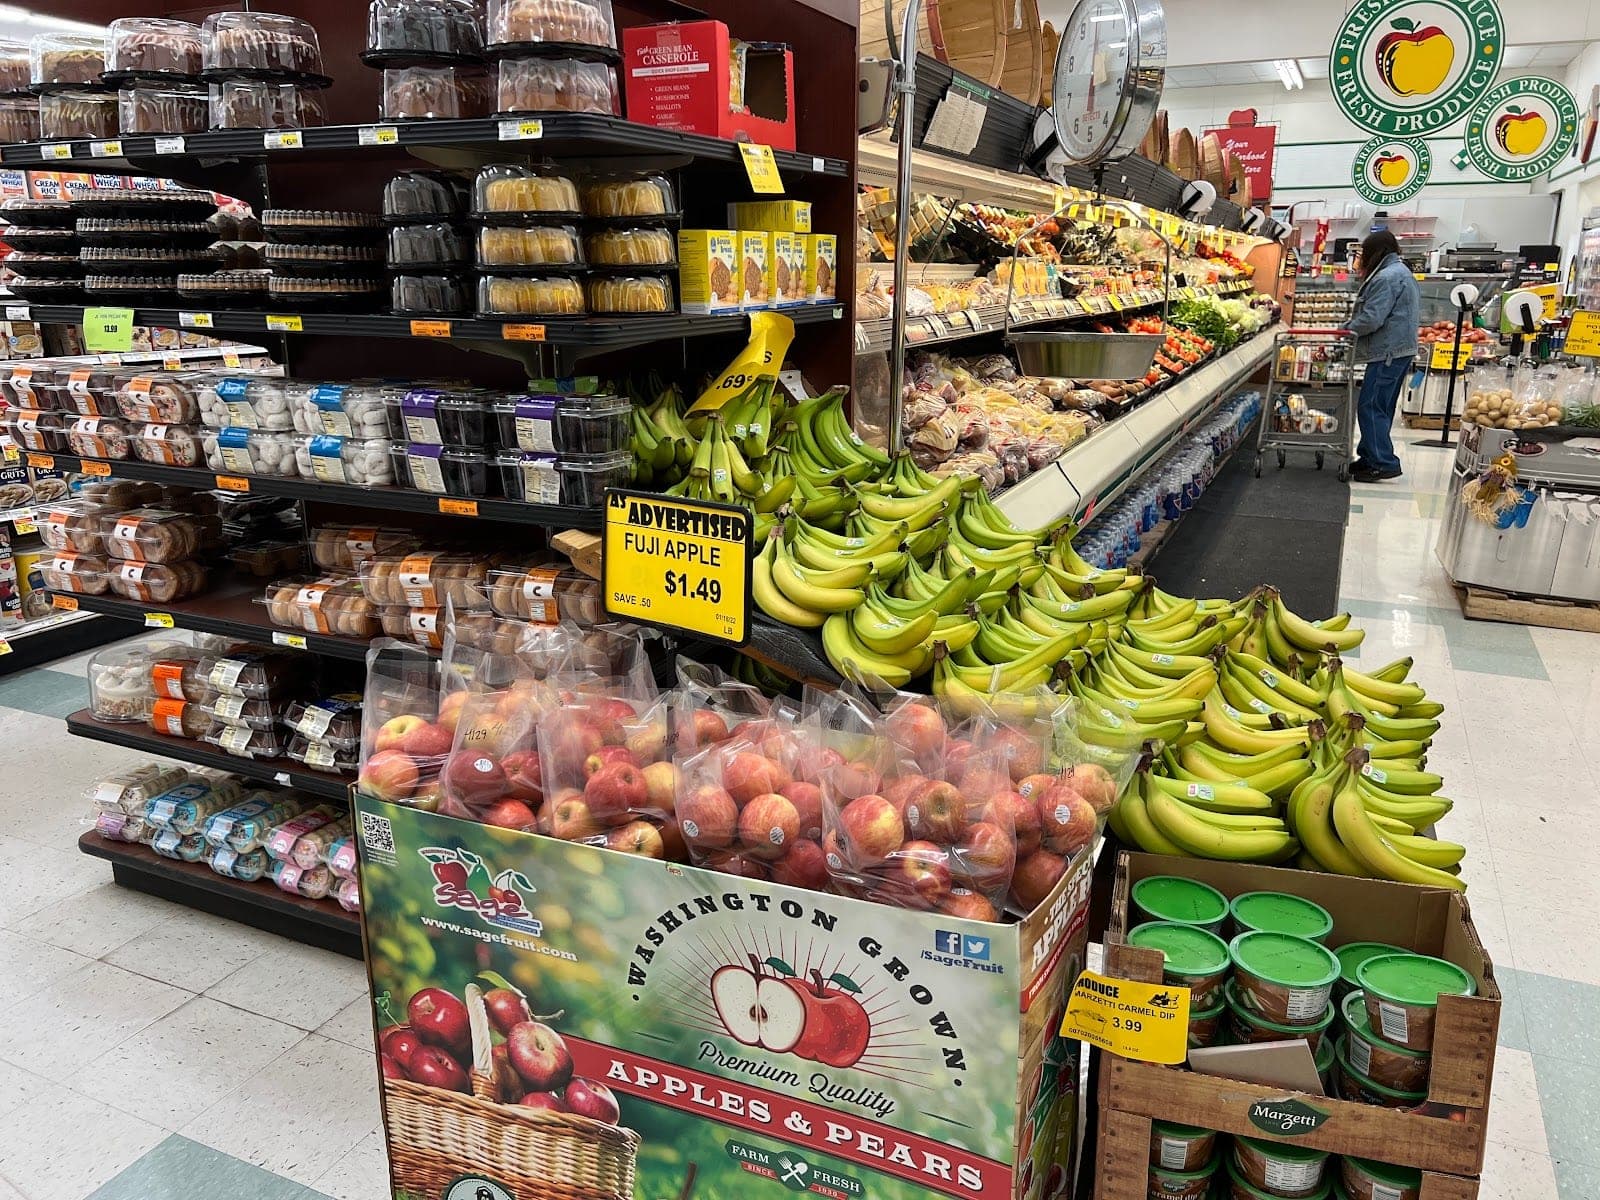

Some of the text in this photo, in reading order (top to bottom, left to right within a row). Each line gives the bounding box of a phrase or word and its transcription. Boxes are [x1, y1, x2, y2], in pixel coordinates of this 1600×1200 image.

[1340, 0, 1388, 50] FRES
[642, 51, 699, 65] CASSEROLE
[1337, 59, 1494, 132] FRESH PRODUCE
[1472, 79, 1576, 124] FRESH PRODUCE
[1087, 126, 1093, 142] 5
[1469, 134, 1573, 178] FRESH PRODUCE
[1354, 171, 1427, 203] FRESH PRODUCE
[0, 470, 26, 480] GRITS
[628, 502, 746, 541] ADVERTISED
[625, 532, 721, 567] FUJI APPLE
[614, 592, 651, 608] SAVE .50
[664, 569, 722, 604] $1.49
[723, 625, 733, 635] LB
[465, 729, 487, 741] 4129
[420, 916, 578, 962] www.sagefruit.com
[920, 949, 1004, 974] /SageFruit
[628, 893, 967, 1071] WASHINGTON GROWN
[1075, 990, 1176, 1020] MARZETTI CARMEL DIP
[1112, 1017, 1142, 1033] 3.99
[698, 1040, 896, 1119] Premium Quality
[606, 1060, 983, 1192] APPLES & PEARS
[1253, 1104, 1317, 1130] Marzetti
[732, 1145, 860, 1193] FARM FRESH
